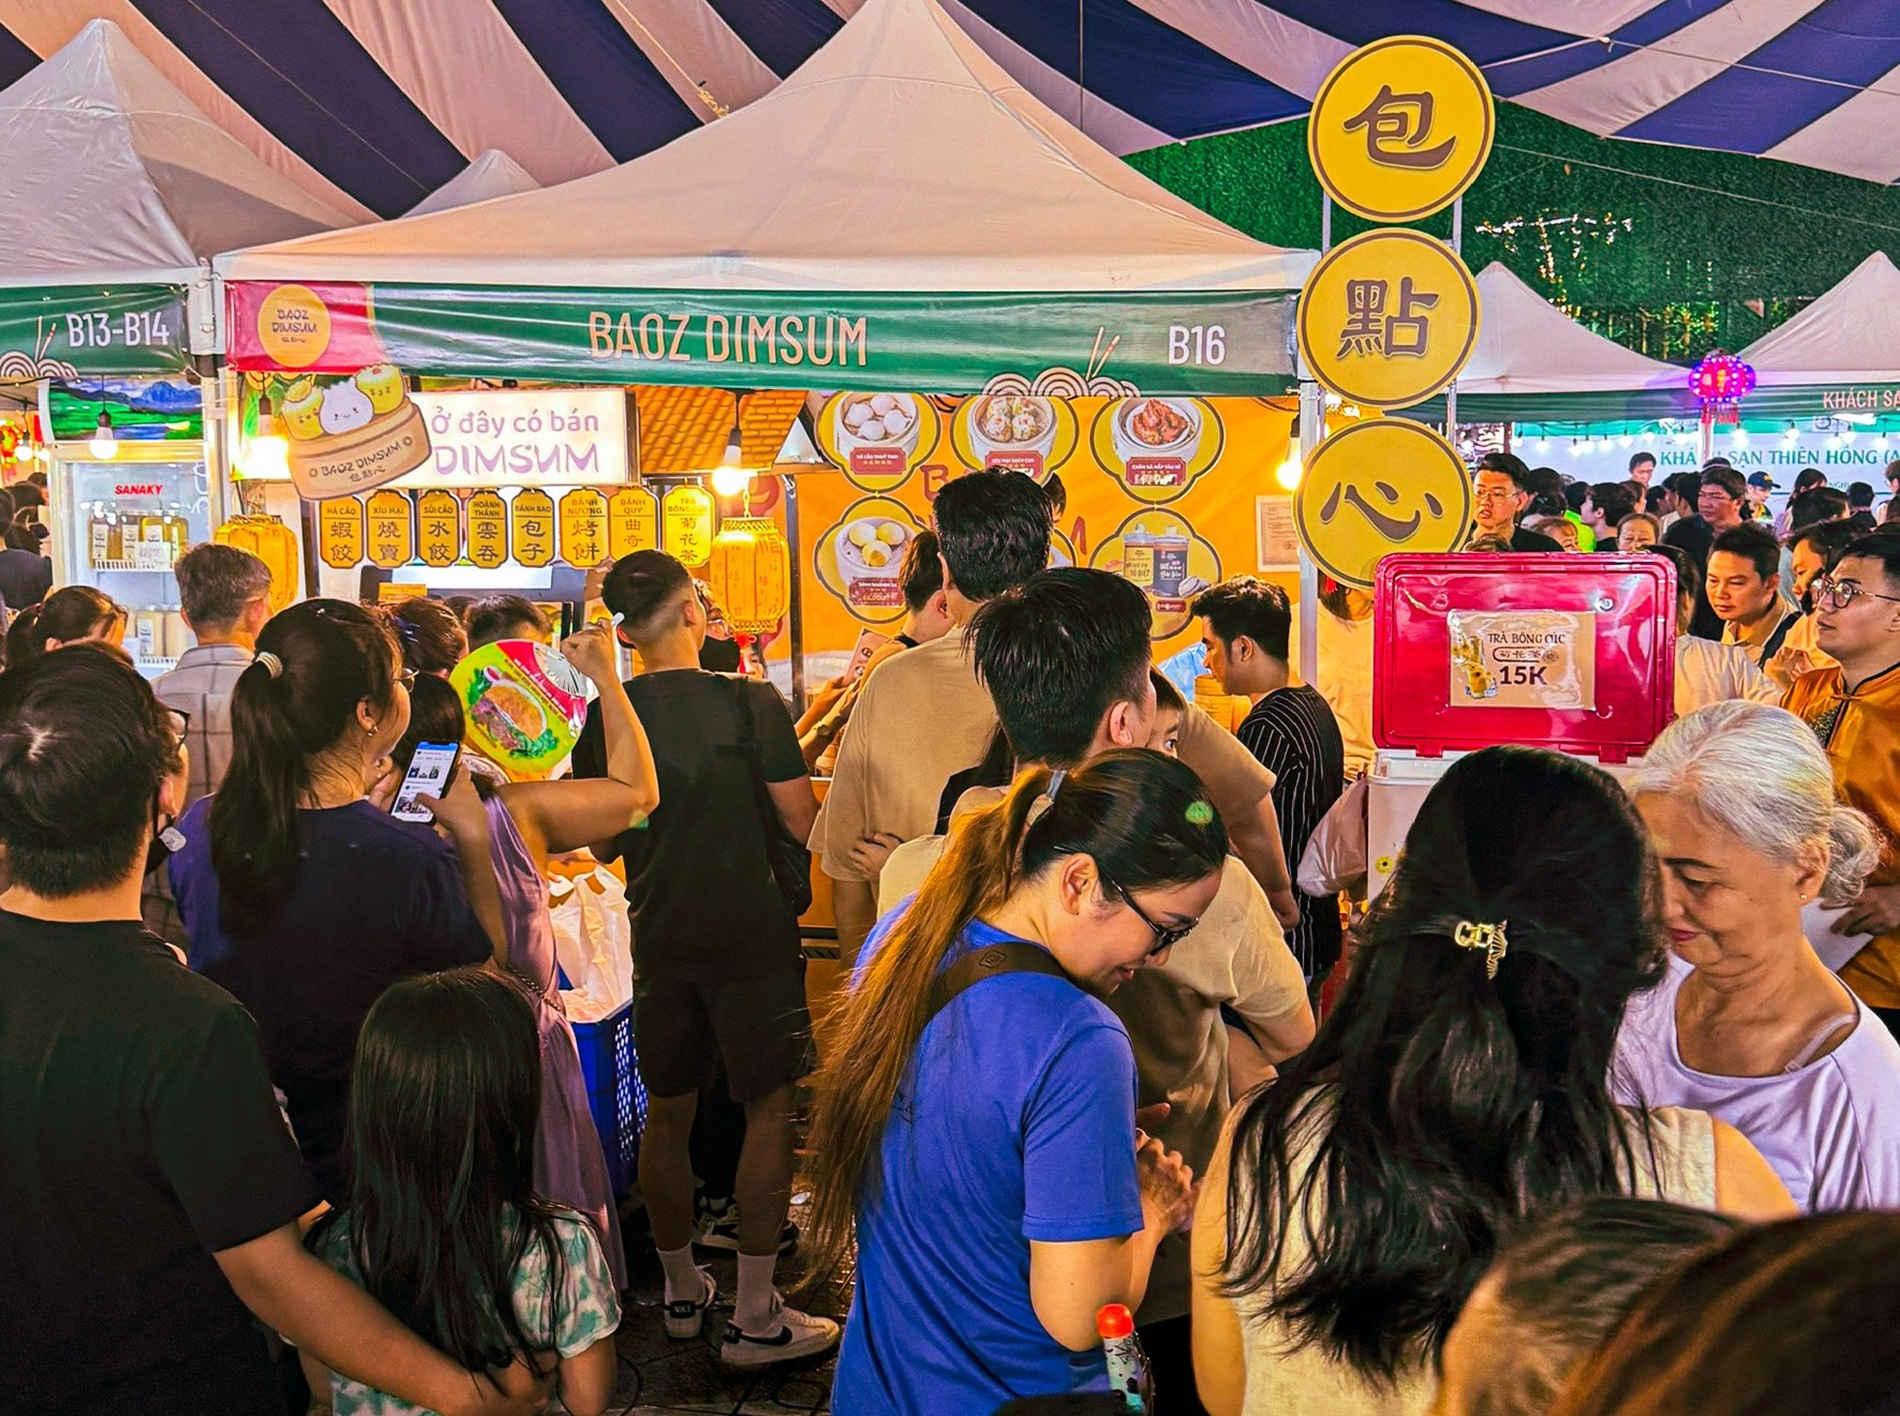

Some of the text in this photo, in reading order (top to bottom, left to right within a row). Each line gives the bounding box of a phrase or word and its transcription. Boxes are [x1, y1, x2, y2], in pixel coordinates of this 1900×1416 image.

[277, 309, 309, 320] BAOZ
[66, 311, 170, 347] B13-B14
[272, 322, 317, 333] DIMSUM
[588, 311, 867, 366] BAOZ DIMSUM
[1168, 325, 1226, 365] B16
[1822, 386, 1878, 409] KHÁCH
[431, 405, 599, 439] Ở đây có bán
[321, 440, 402, 477] BAOZ DIMSUM
[432, 443, 600, 475] DIMSUM
[1728, 450, 1763, 468] SẠN
[1768, 445, 1819, 465] THIÊN
[115, 484, 163, 496] SANAKY
[620, 497, 646, 506] BÁNH
[514, 502, 552, 513] BÁNH BAO
[623, 506, 643, 515] QUY
[427, 520, 451, 561] 水餃
[476, 521, 500, 562] 雲吞
[520, 519, 546, 561] 包子
[1487, 631, 1508, 644] TRÀ
[1511, 631, 1543, 644] BÔNG
[1499, 666, 1548, 685] 15K
